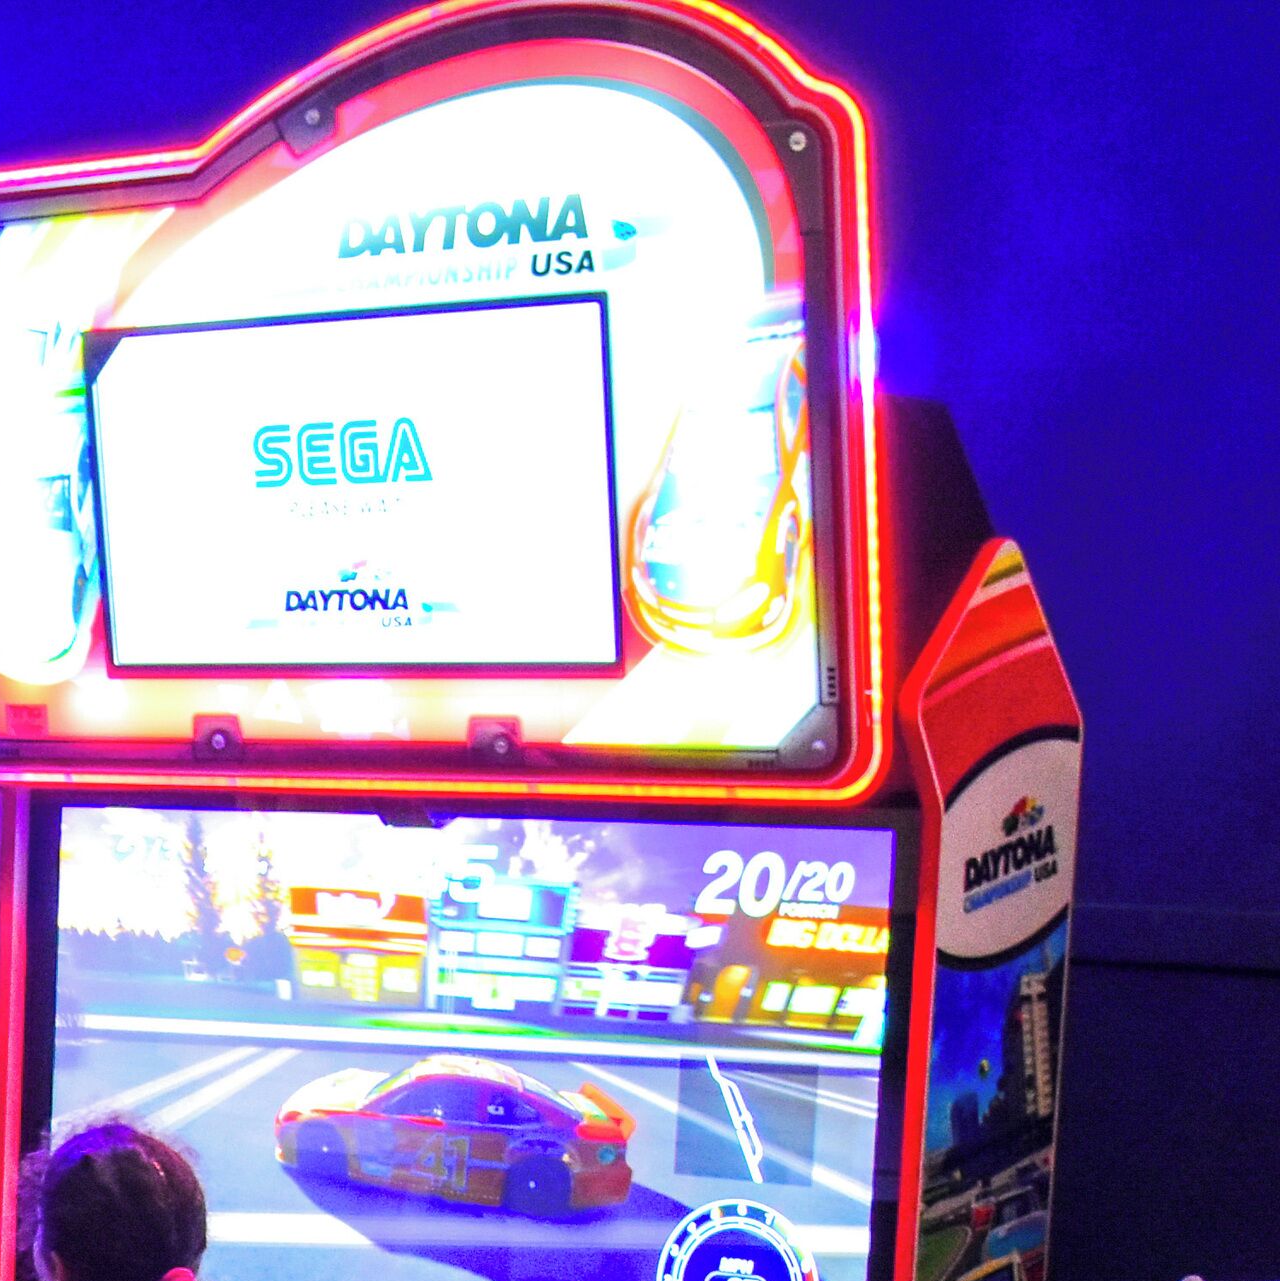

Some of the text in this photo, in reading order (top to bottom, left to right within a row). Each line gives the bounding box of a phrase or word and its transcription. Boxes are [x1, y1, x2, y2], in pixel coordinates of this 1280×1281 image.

[338, 193, 589, 259] DAYTONA
[530, 250, 596, 277] USA
[252, 417, 434, 488] SEGA
[285, 588, 409, 612] DAYTONA
[381, 616, 413, 627] USA
[963, 825, 1056, 893] DAYTONA
[1033, 859, 1058, 883] USA
[694, 850, 856, 917] 20/20
